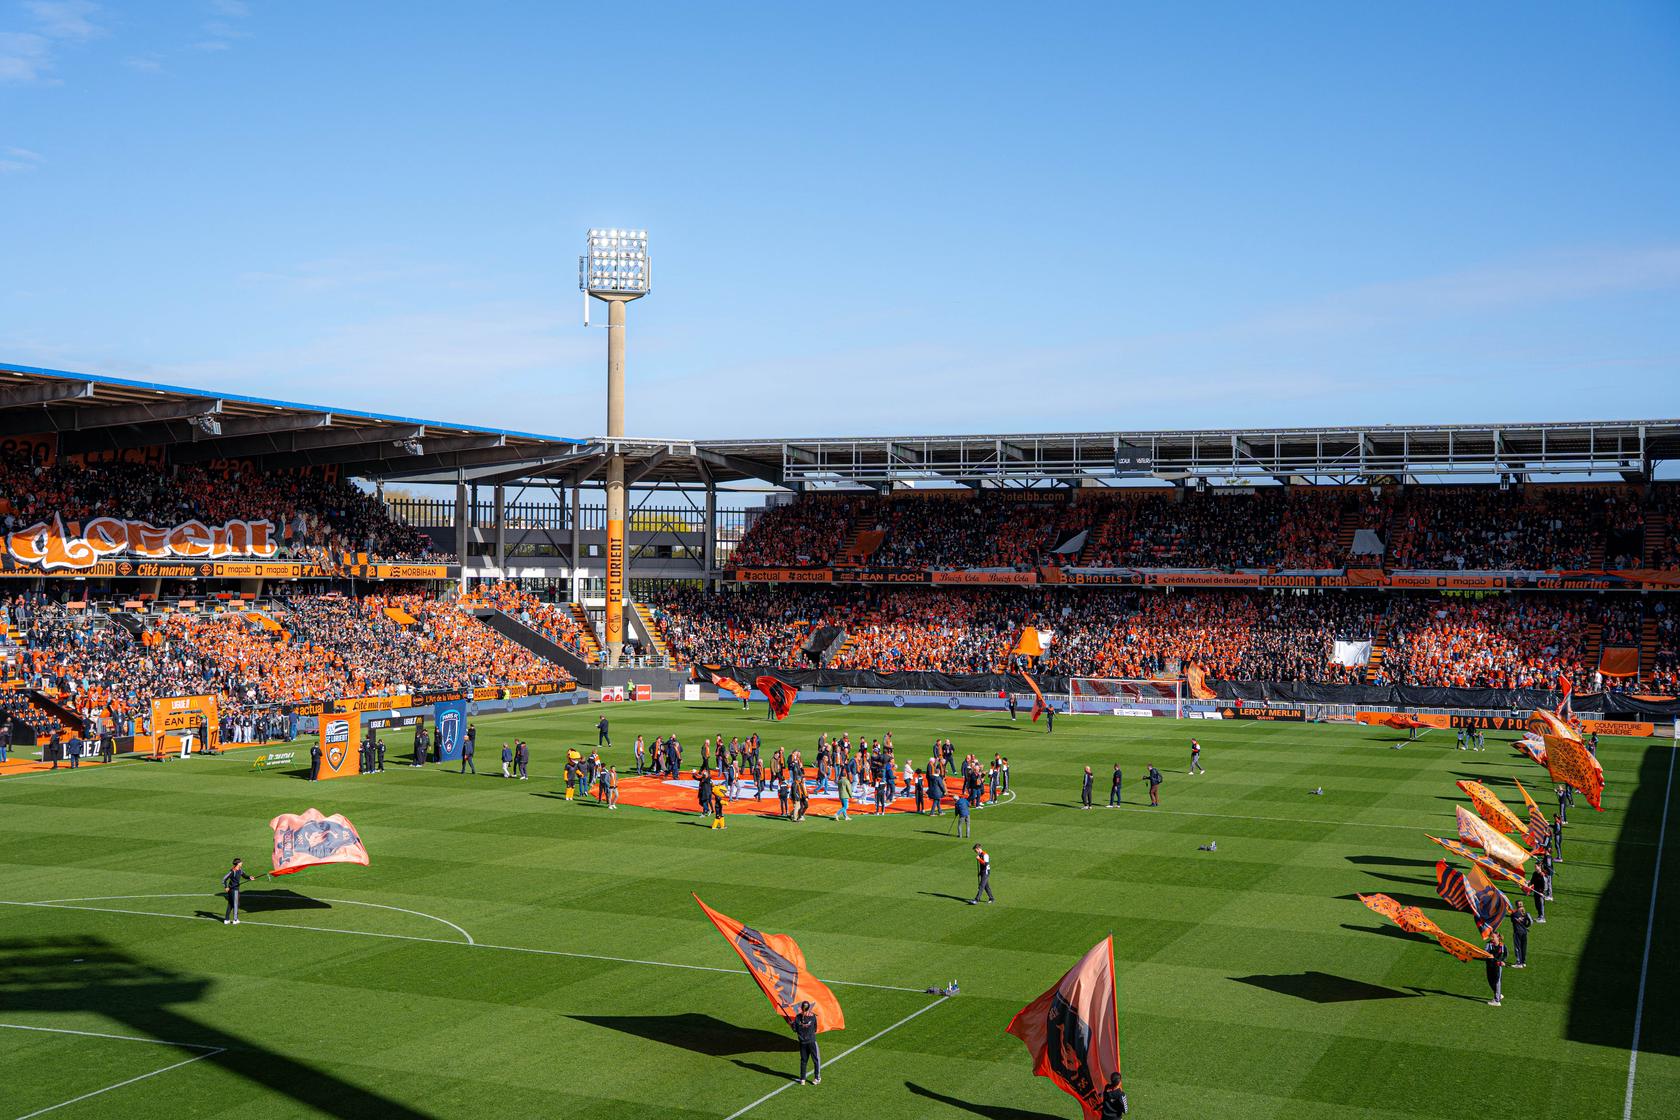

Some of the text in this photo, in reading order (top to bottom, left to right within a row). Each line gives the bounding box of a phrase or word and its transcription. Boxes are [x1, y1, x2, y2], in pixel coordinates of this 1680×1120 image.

[137, 563, 196, 577] Cité marine
[401, 568, 437, 576] MORBIHAN
[610, 537, 622, 603] FC LORIENT
[752, 571, 825, 581] actual actual
[860, 573, 884, 582] JEAN
[888, 573, 925, 582] FLOCH
[1086, 576, 1123, 584] HOTELS
[1260, 576, 1316, 586] ACADOMIA
[1398, 577, 1487, 587] mapab mapab
[1537, 578, 1610, 589] Cité marine
[299, 703, 324, 715] actual
[1239, 708, 1301, 718] LEROY MERLIN
